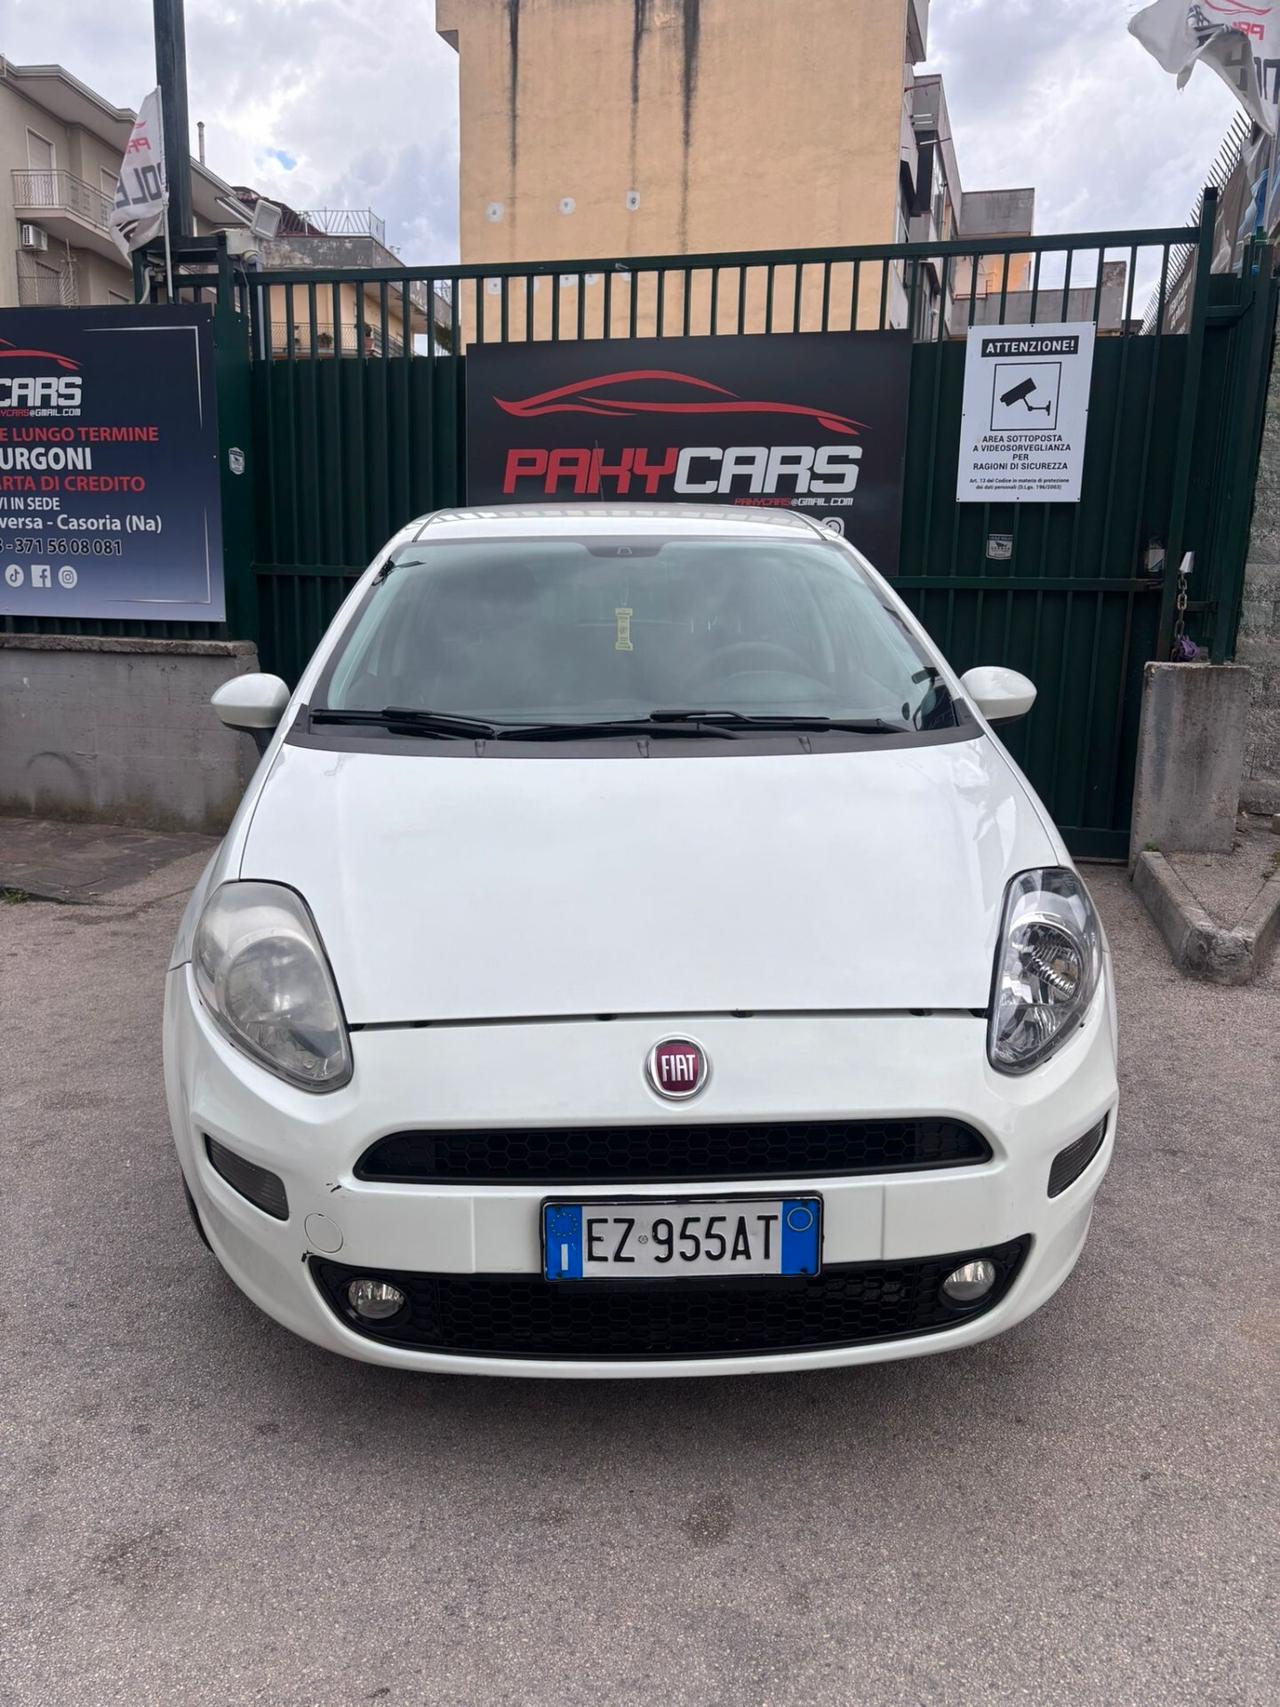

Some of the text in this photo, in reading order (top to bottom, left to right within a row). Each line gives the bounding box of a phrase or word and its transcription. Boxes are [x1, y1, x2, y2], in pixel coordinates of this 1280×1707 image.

[985, 339, 1075, 354] ATTENZIONE!
[0, 376, 83, 407] CARS
[13, 427, 75, 442] LUNGO
[78, 427, 159, 441] TERMINE
[982, 434, 1063, 443] AREA SOTTOPOSTA
[981, 444, 1071, 452] VIDEOSORVEGLIANZA
[0, 447, 92, 470] URGONI
[1012, 453, 1029, 461] PER
[503, 446, 863, 494] PAKYCARS
[972, 462, 1068, 470] RAGIONI DI SICUREZZA
[41, 476, 59, 491] DI
[64, 476, 146, 492] CREDITO
[11, 497, 24, 510] IN
[27, 497, 61, 510] SEDE
[0, 517, 43, 529] versa
[57, 514, 121, 531] Casoria
[126, 514, 162, 533] (Na)
[15, 538, 43, 554] 371
[47, 538, 67, 554] 56
[70, 538, 90, 555] 08
[93, 538, 123, 555] 081
[661, 1054, 696, 1081] FIAT
[561, 1214, 779, 1270] I EZ 955AT
